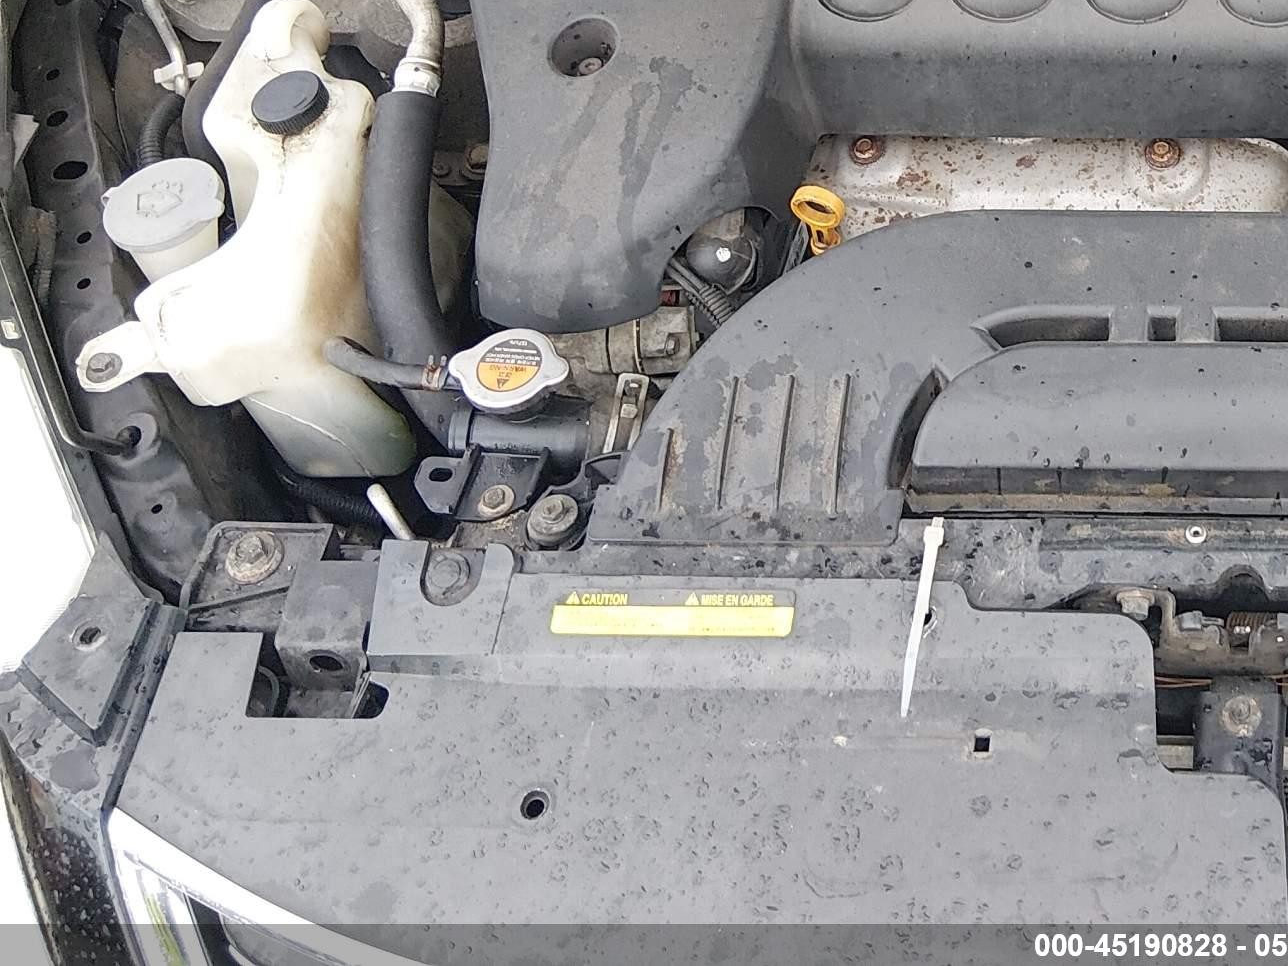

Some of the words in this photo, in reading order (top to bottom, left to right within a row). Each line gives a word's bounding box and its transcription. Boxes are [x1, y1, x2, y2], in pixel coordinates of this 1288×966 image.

[489, 364, 527, 372] WARNING
[581, 593, 628, 605] CAUTION
[701, 594, 723, 605] MISE
[725, 594, 739, 605] EN
[740, 594, 775, 606] GARDE
